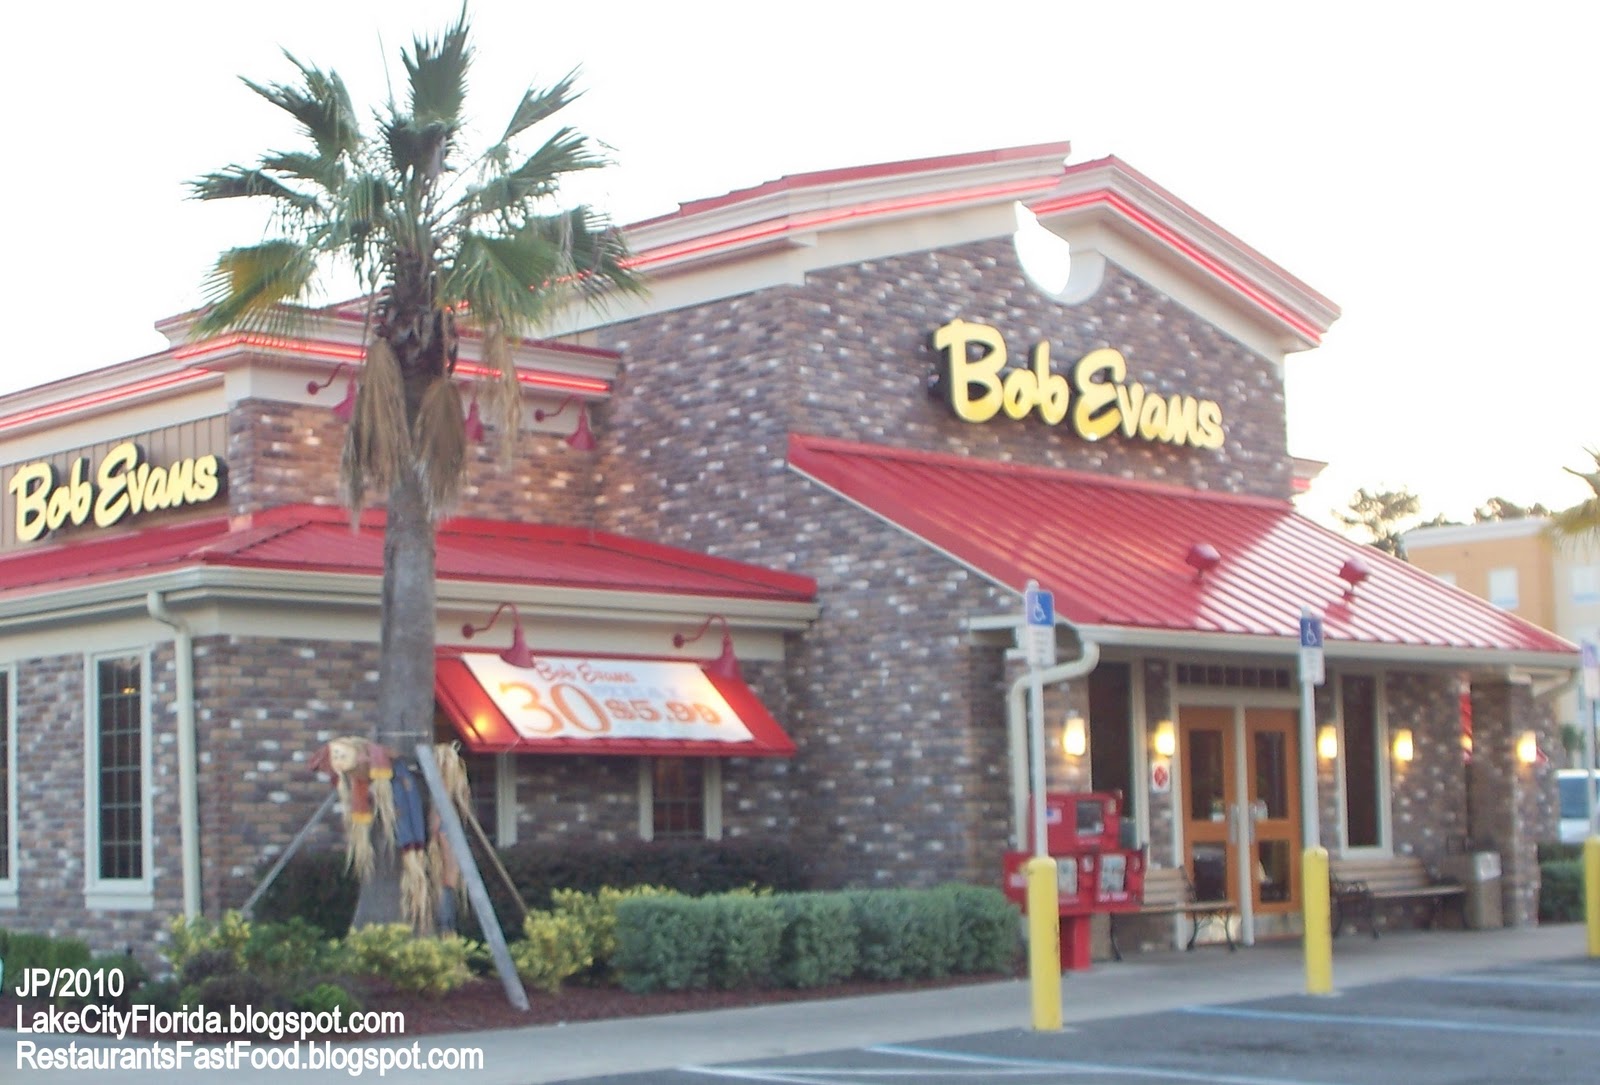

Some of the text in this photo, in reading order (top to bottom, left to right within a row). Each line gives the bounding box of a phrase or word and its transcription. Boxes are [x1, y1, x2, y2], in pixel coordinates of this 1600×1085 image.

[934, 318, 1225, 450] Bob Evans
[9, 442, 218, 542] Bob Evans
[498, 681, 611, 734] 30
[535, 660, 637, 683] Bob Evans
